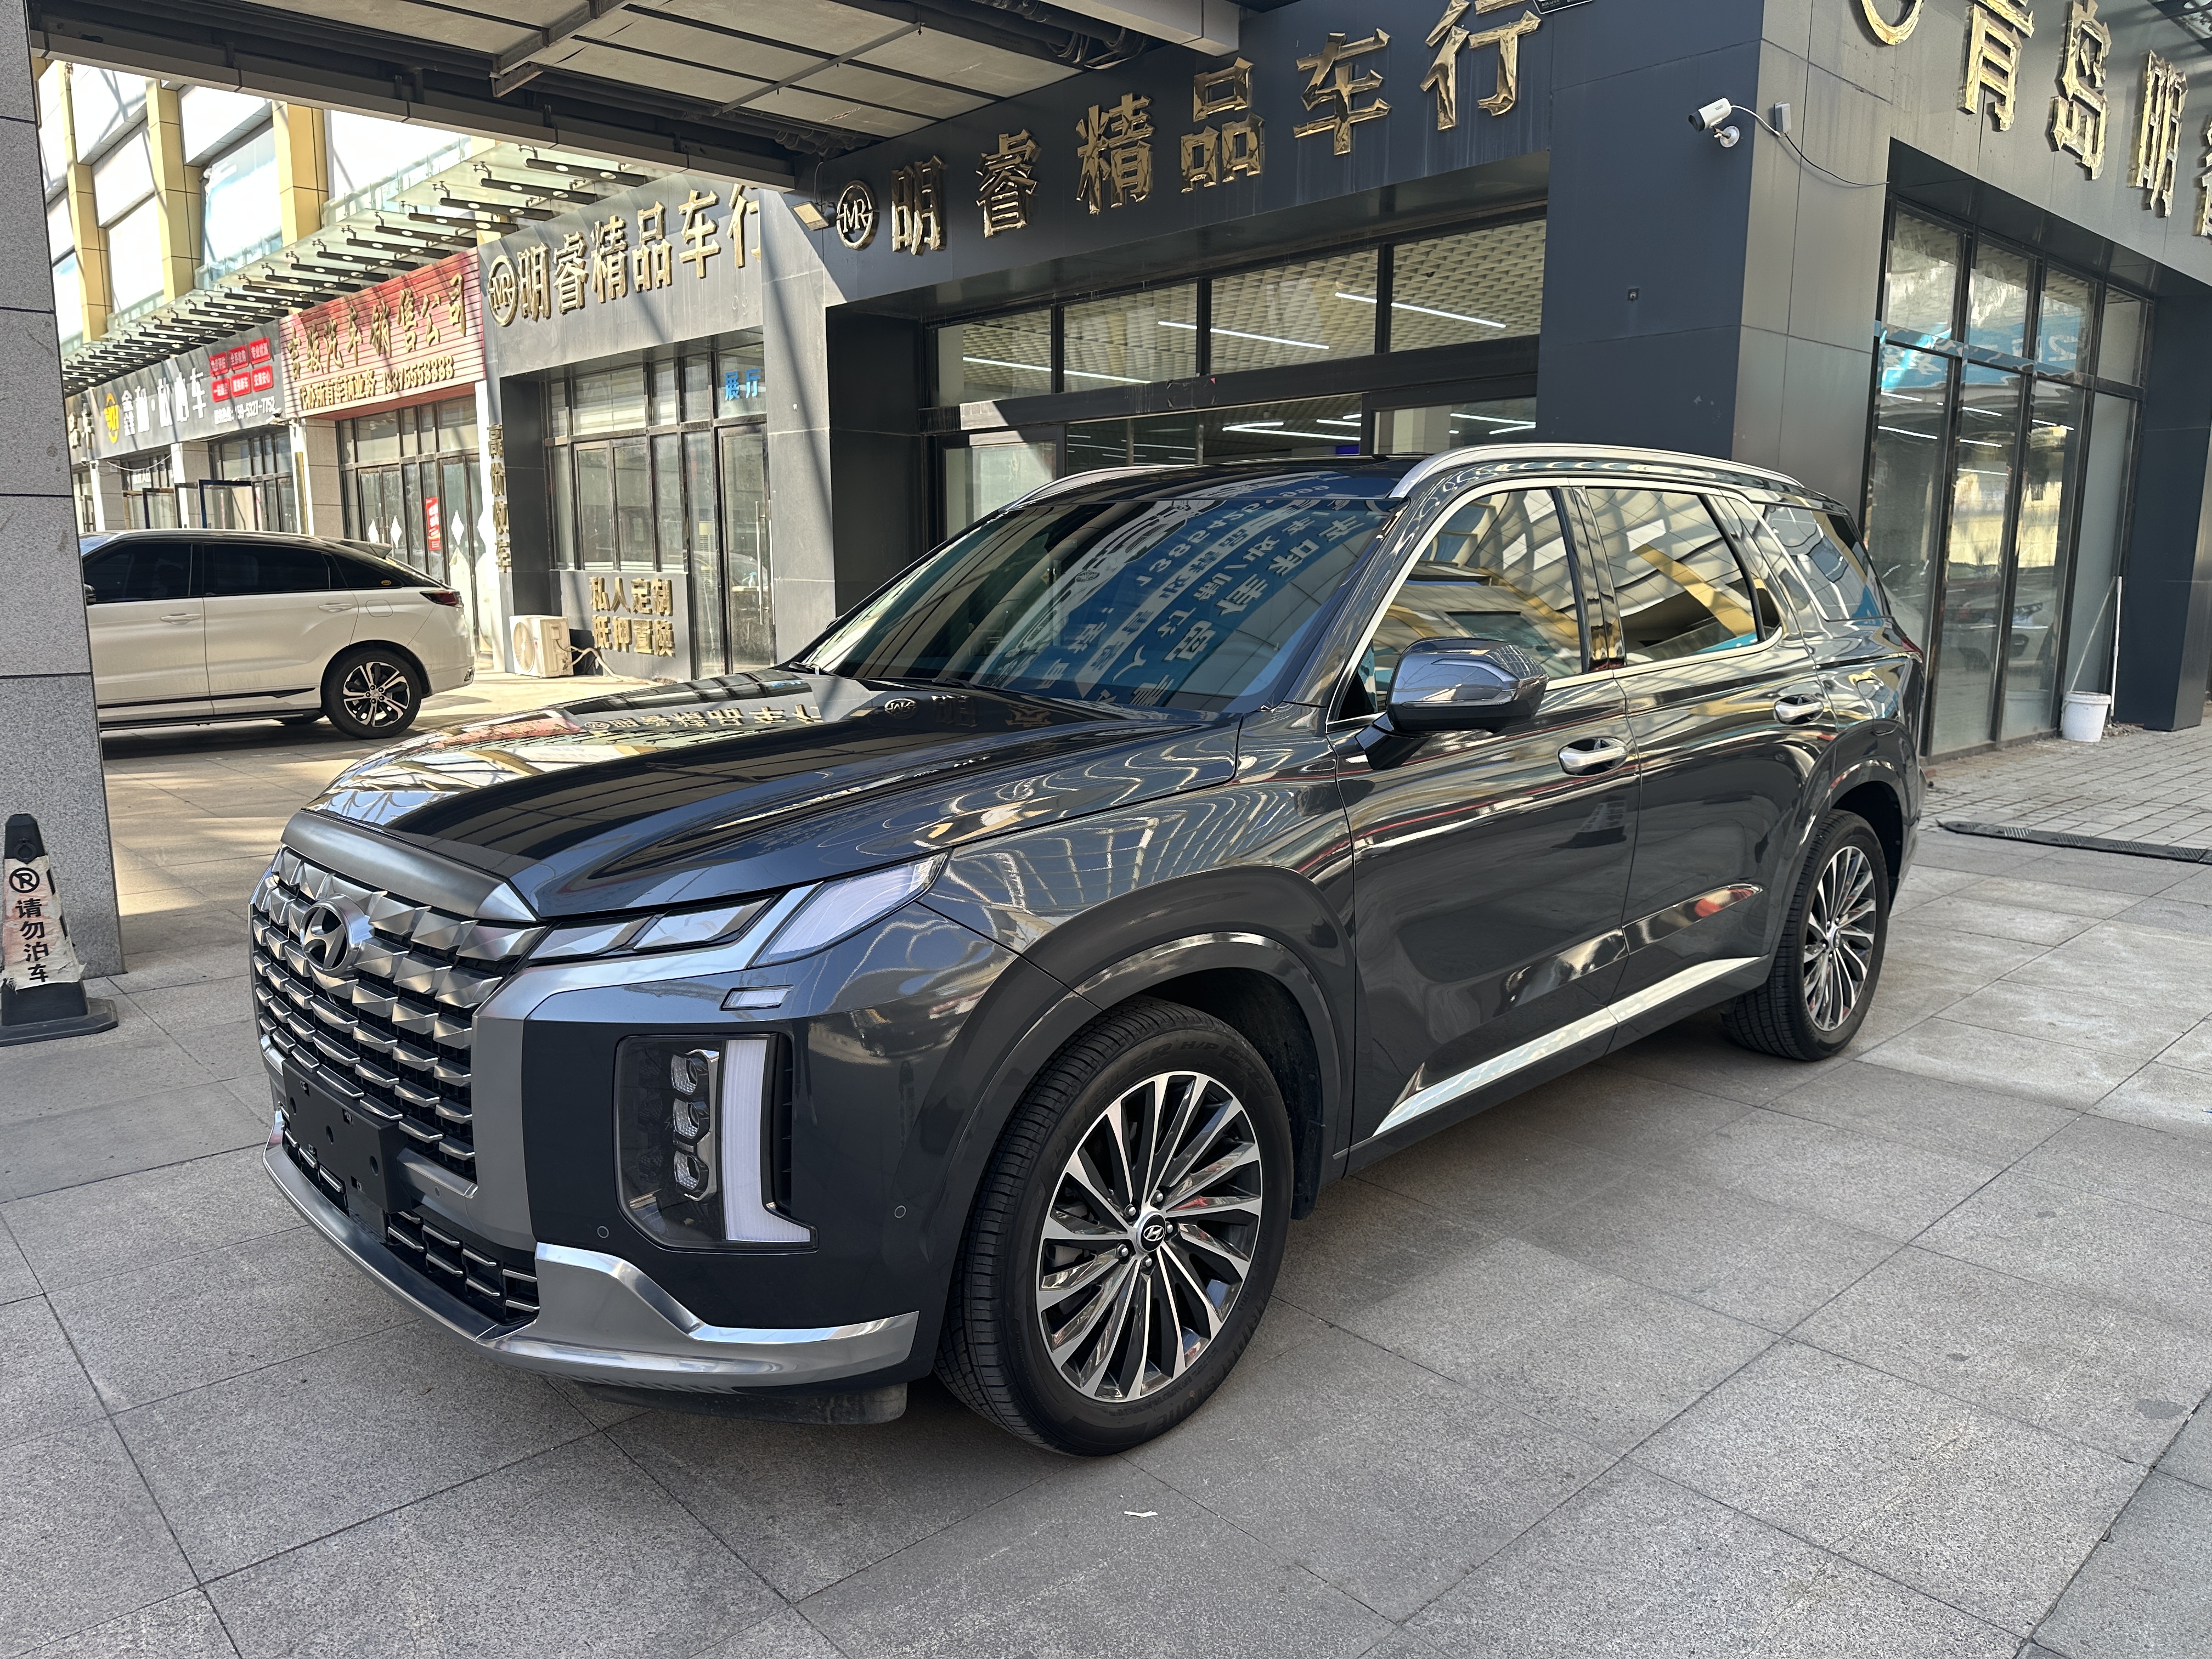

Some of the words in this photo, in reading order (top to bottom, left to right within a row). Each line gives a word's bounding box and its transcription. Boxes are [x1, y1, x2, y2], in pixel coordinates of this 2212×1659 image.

[891, 0, 1542, 256] 明睿精品车行
[1964, 0, 2212, 237] 青岛明
[724, 369, 761, 401] 展厅
[589, 577, 674, 616] 私人定制
[15, 898, 49, 983] 请勿泊车
[1224, 1049, 1256, 1075] SPORT
